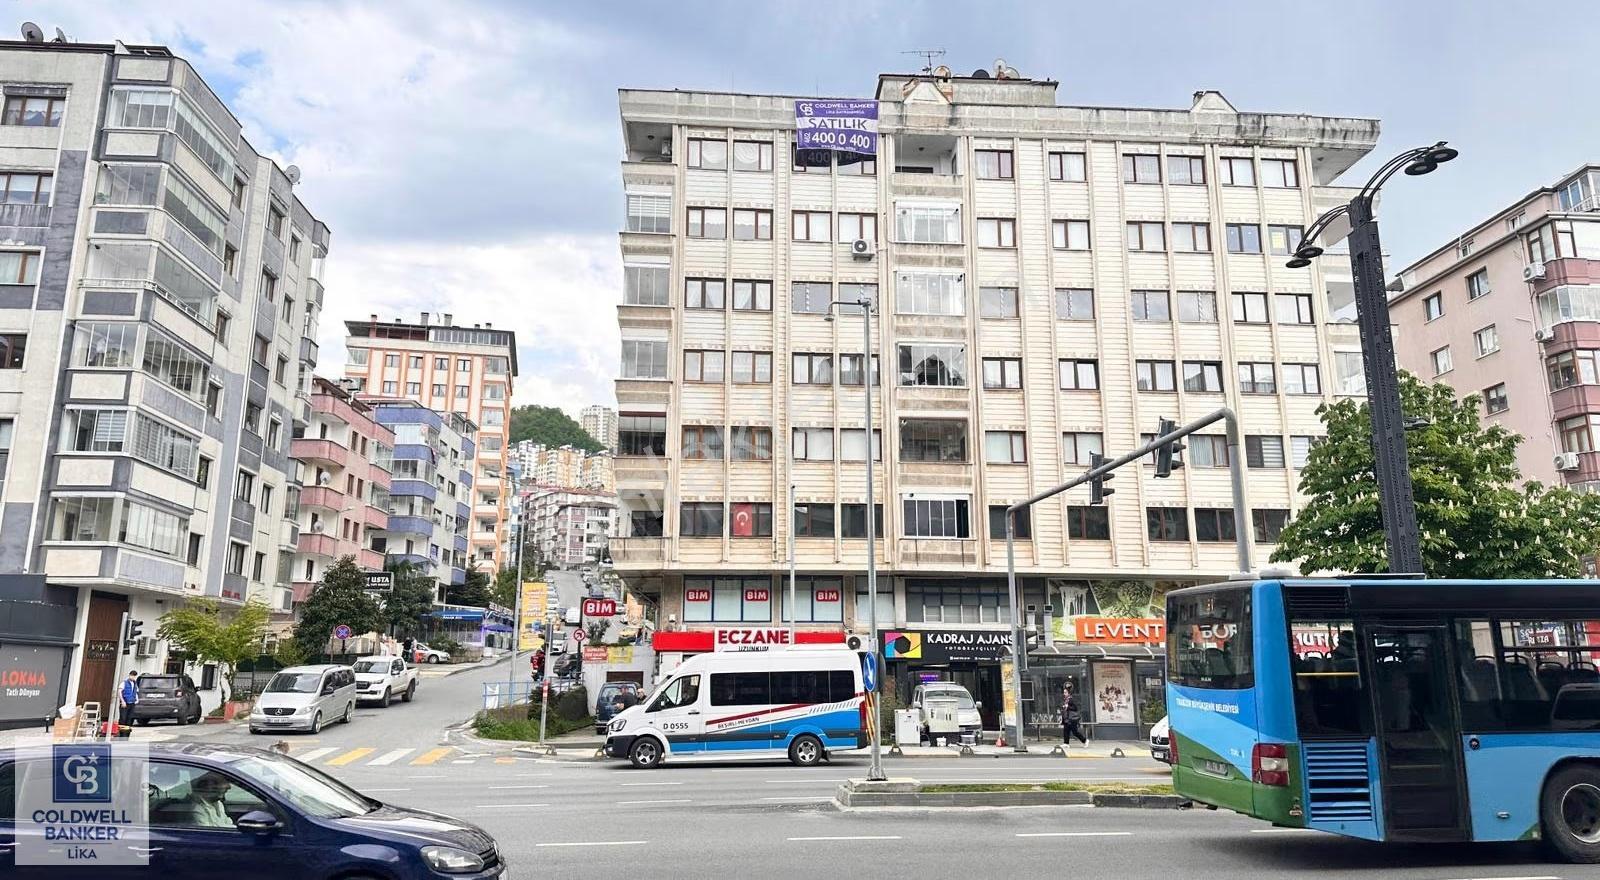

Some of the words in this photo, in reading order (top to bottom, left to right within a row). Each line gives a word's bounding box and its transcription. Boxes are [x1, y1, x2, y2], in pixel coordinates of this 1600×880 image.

[808, 118, 868, 130] SATILIK
[812, 132, 835, 144] 400
[838, 133, 847, 145] 0
[849, 134, 870, 149] 400
[586, 600, 612, 613] BİM
[718, 630, 789, 644] ECZANE
[1083, 622, 1163, 639] LEVENT
[927, 633, 974, 644] KADRAJ
[976, 634, 1013, 645] AJANS
[1, 670, 47, 687] LOKMA
[670, 722, 689, 730] 0555
